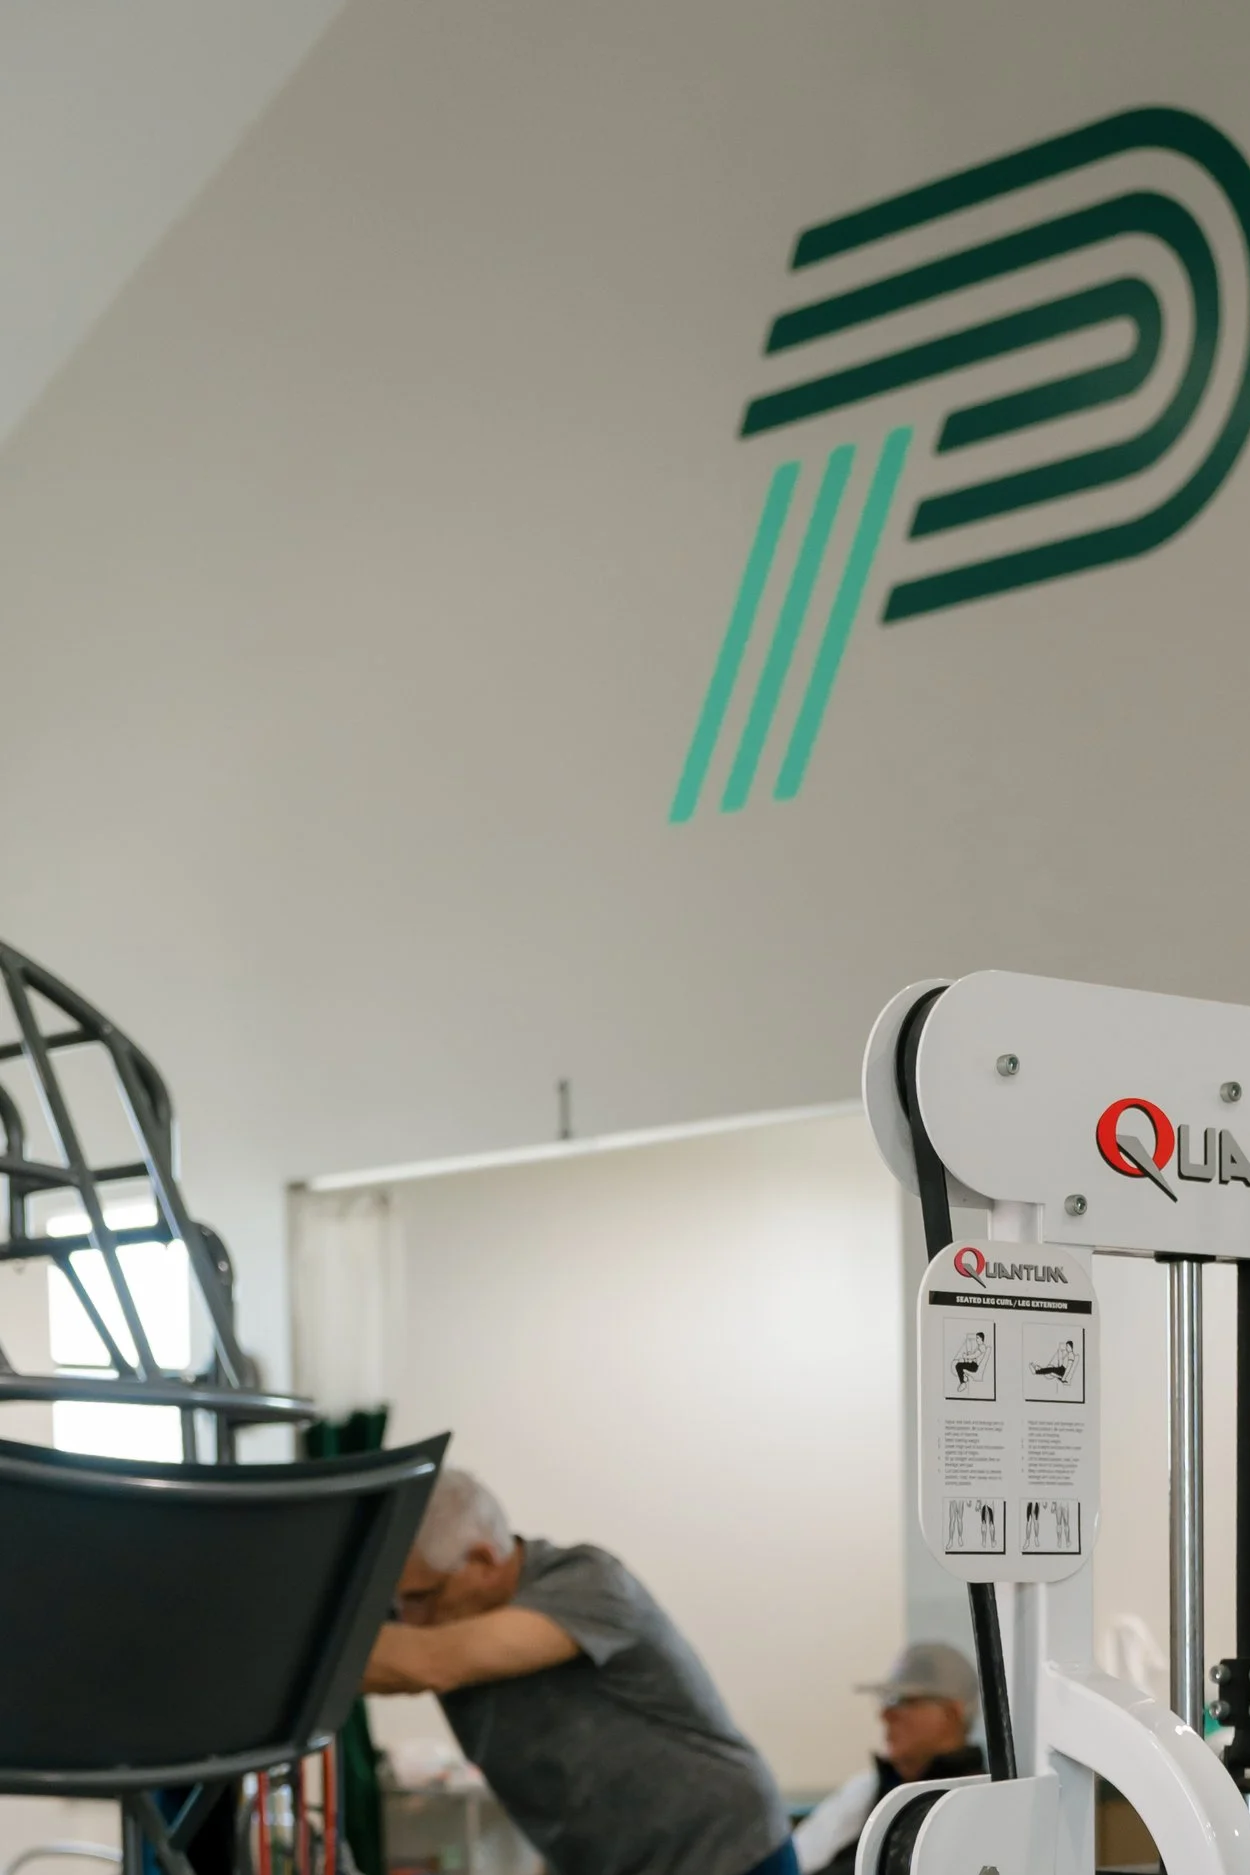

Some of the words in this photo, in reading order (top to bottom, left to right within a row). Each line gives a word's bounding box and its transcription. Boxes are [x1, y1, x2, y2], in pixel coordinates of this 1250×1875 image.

[953, 1247, 1069, 1289] QUANTUM
[955, 1295, 982, 1304] SEATED
[982, 1297, 995, 1305] LEG
[996, 1298, 1013, 1306] CURL
[1018, 1299, 1031, 1308] LEG
[1031, 1300, 1068, 1310] EXTENSION
